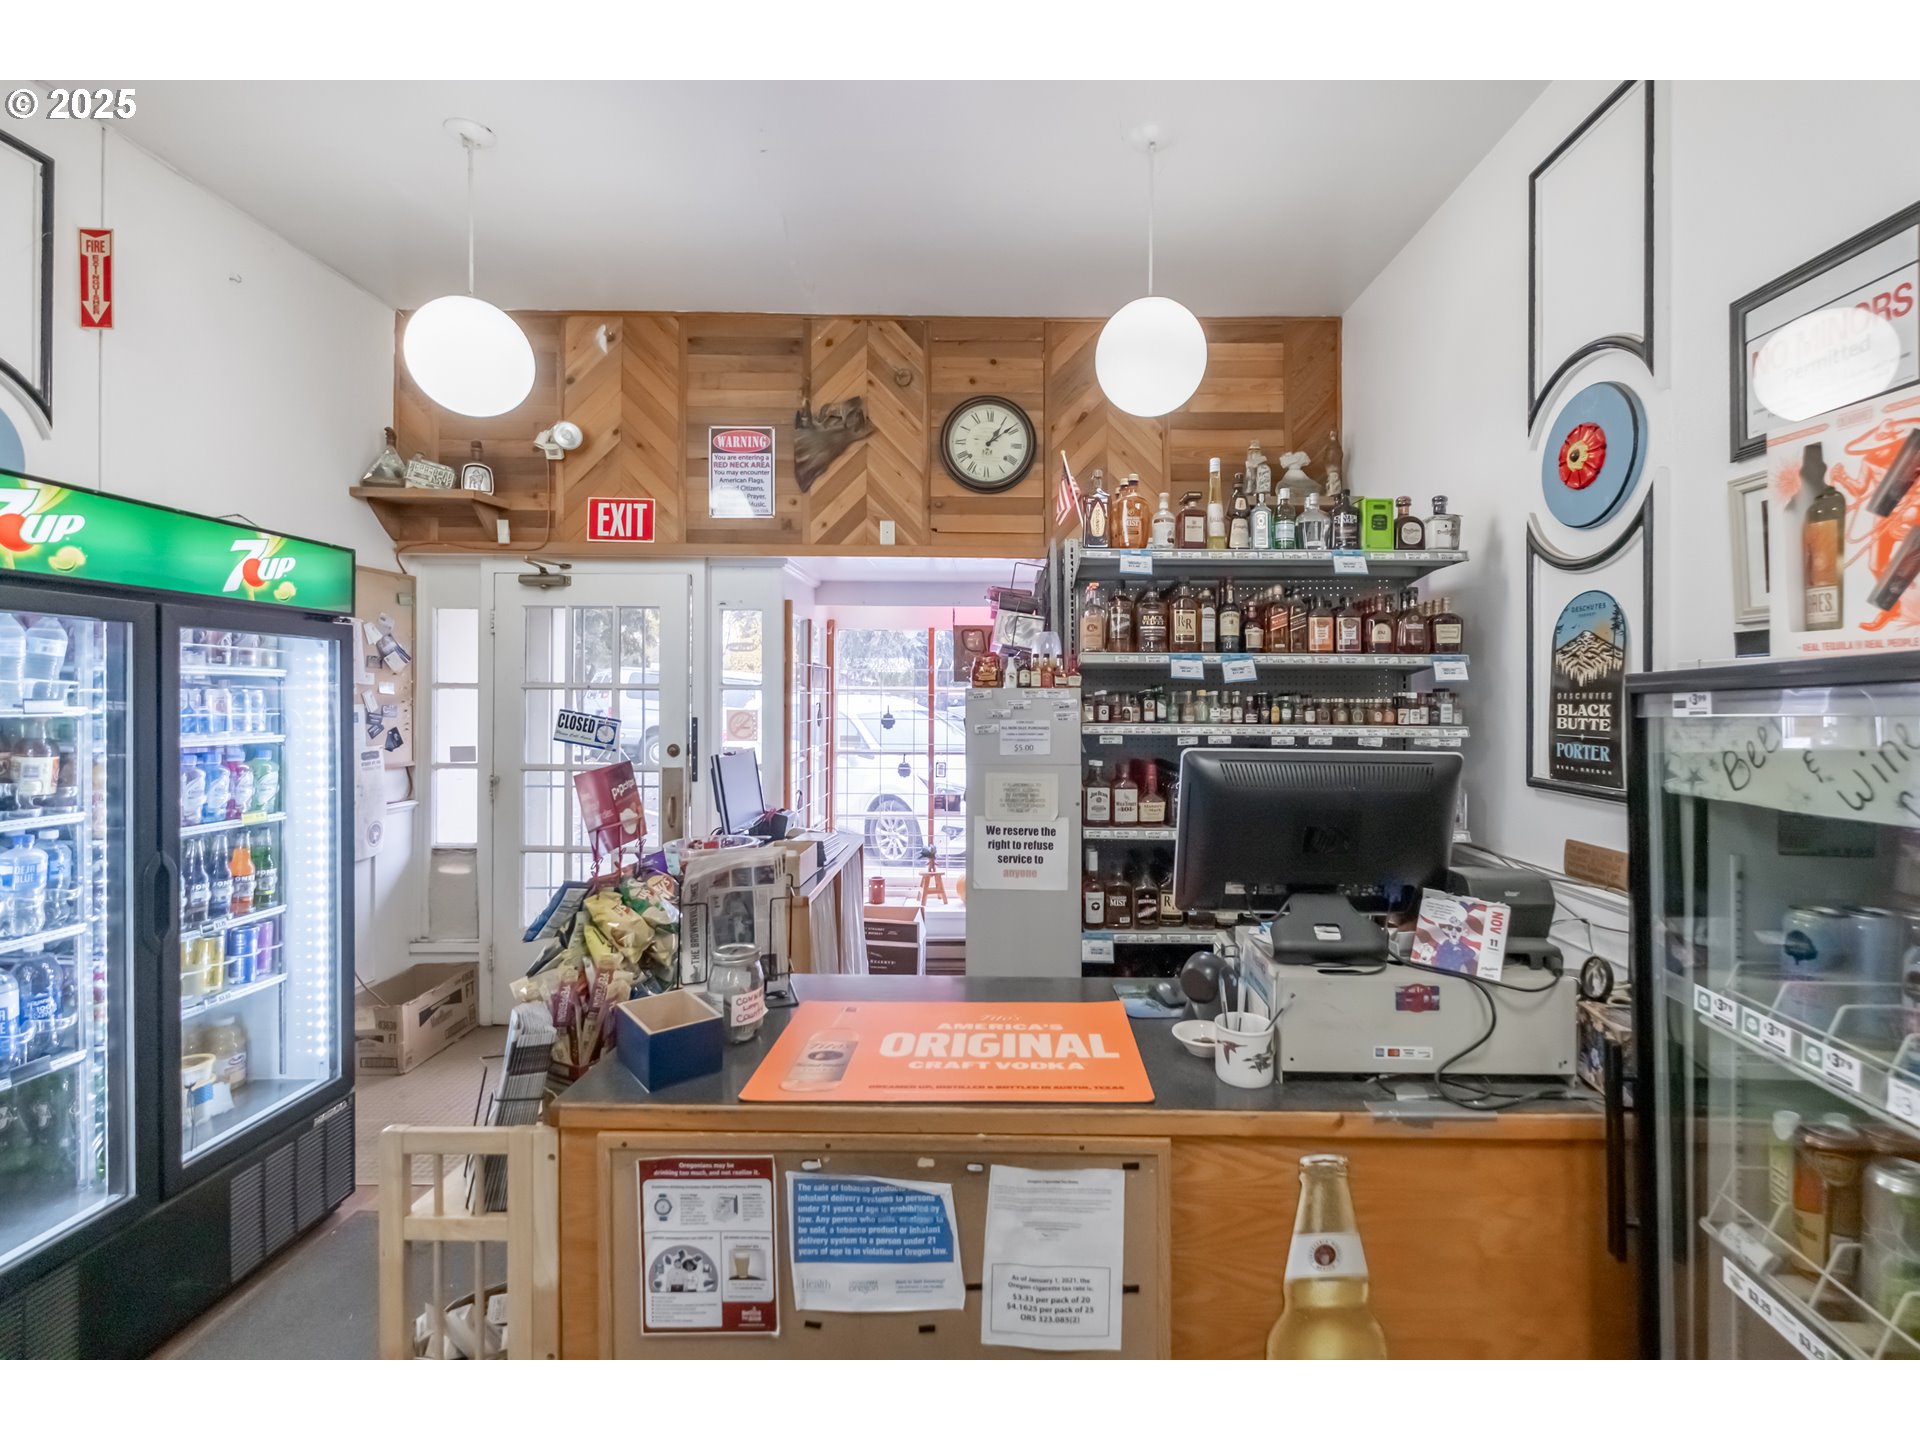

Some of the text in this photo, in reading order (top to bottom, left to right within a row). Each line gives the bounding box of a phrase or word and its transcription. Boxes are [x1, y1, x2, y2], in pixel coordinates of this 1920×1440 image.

[86, 240, 105, 253] FIRE
[717, 435, 767, 448] WARNING
[738, 454, 765, 462] entering
[597, 502, 648, 537] EXIT
[1570, 602, 1607, 613] DESCHUTES
[1556, 692, 1612, 700] DESCHUTES
[1556, 703, 1612, 717] BLACK
[557, 713, 596, 734] CLOSED
[1556, 716, 1612, 732] BUTTE
[1556, 742, 1611, 762] PORTER
[986, 825, 1056, 837] We reserve the
[987, 839, 1054, 851] right to refuse
[997, 854, 1044, 864] service to
[1002, 868, 1038, 879] anyone
[689, 882, 699, 902] TIMES
[1489, 911, 1504, 935] NOV
[1489, 939, 1498, 948] 11
[690, 949, 700, 965] THE
[936, 1022, 1064, 1031] AMERICA'S
[879, 1032, 1121, 1060] ORIGINAL
[908, 1060, 1085, 1071] CRAFT VODKA
[840, 1184, 870, 1193] tobacco
[798, 1205, 820, 1213] under
[822, 1205, 831, 1213] 21
[832, 1206, 854, 1214] years
[855, 1205, 863, 1213] of
[865, 1206, 879, 1215] age
[890, 1205, 929, 1214] prohibited
[930, 1204, 940, 1213] by
[798, 1237, 828, 1246] delivery
[830, 1238, 857, 1246] system
[859, 1237, 867, 1245] to
[876, 1238, 901, 1246] person
[903, 1237, 926, 1245] under
[798, 1248, 819, 1256] years
[829, 1248, 843, 1256] age
[862, 1247, 893, 1255] violation
[904, 1247, 931, 1256] Oregon
[932, 1247, 949, 1255] law.
[802, 1279, 832, 1290] Health
[1028, 1276, 1053, 1285] January
[1012, 1293, 1091, 1304] $3.33 per pack of 20
[1006, 1302, 1094, 1314] $4.1625 per pack of 25
[1020, 1314, 1037, 1322] ORS
